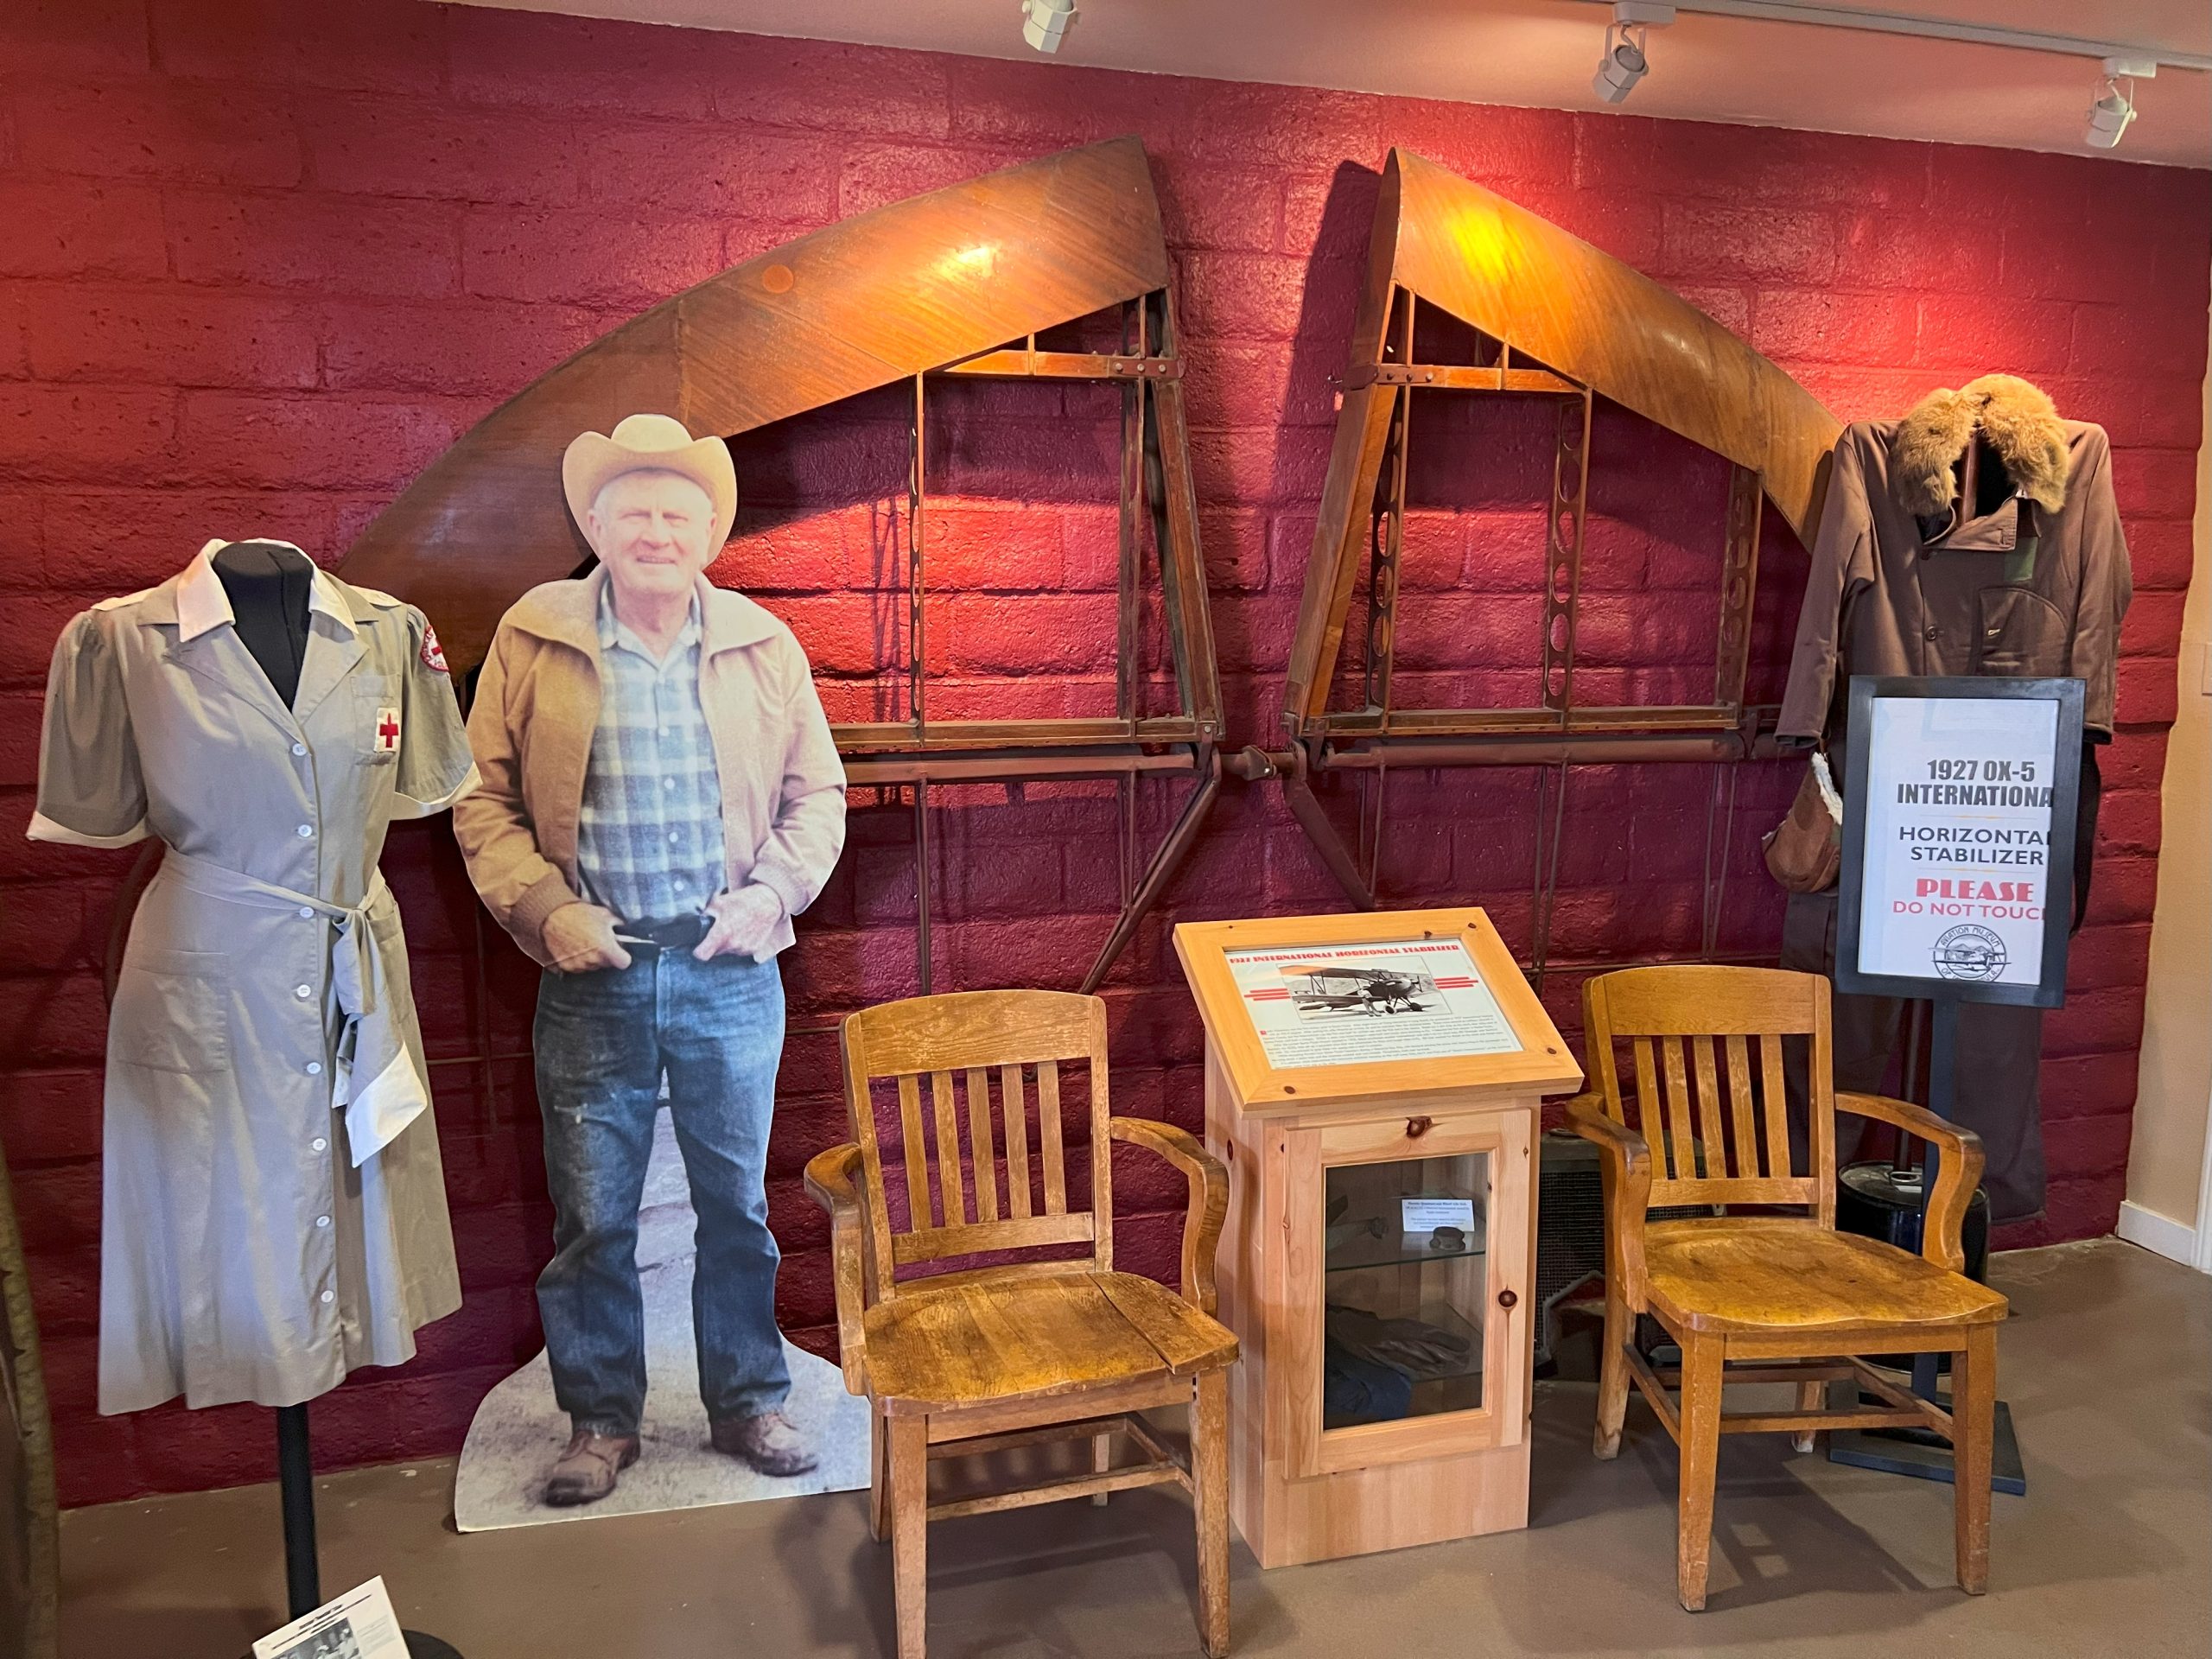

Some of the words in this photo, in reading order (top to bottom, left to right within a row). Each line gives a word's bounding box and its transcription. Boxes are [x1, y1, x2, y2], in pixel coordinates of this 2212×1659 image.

[1928, 760, 1979, 780] 1927
[1983, 760, 2035, 782] OX-5
[1910, 847, 2044, 866] STABILIZER
[1916, 879, 2034, 902] PLEASE
[1893, 901, 1923, 914] DO
[1930, 903, 1974, 917] NOT
[1940, 926, 1969, 947] AVIATION
[1972, 926, 2001, 948] MUSEUM
[1253, 951, 1332, 962] INTERNATIONAL
[1335, 947, 1401, 957] HORIZONTAL
[1402, 944, 1460, 954] STABILIZER
